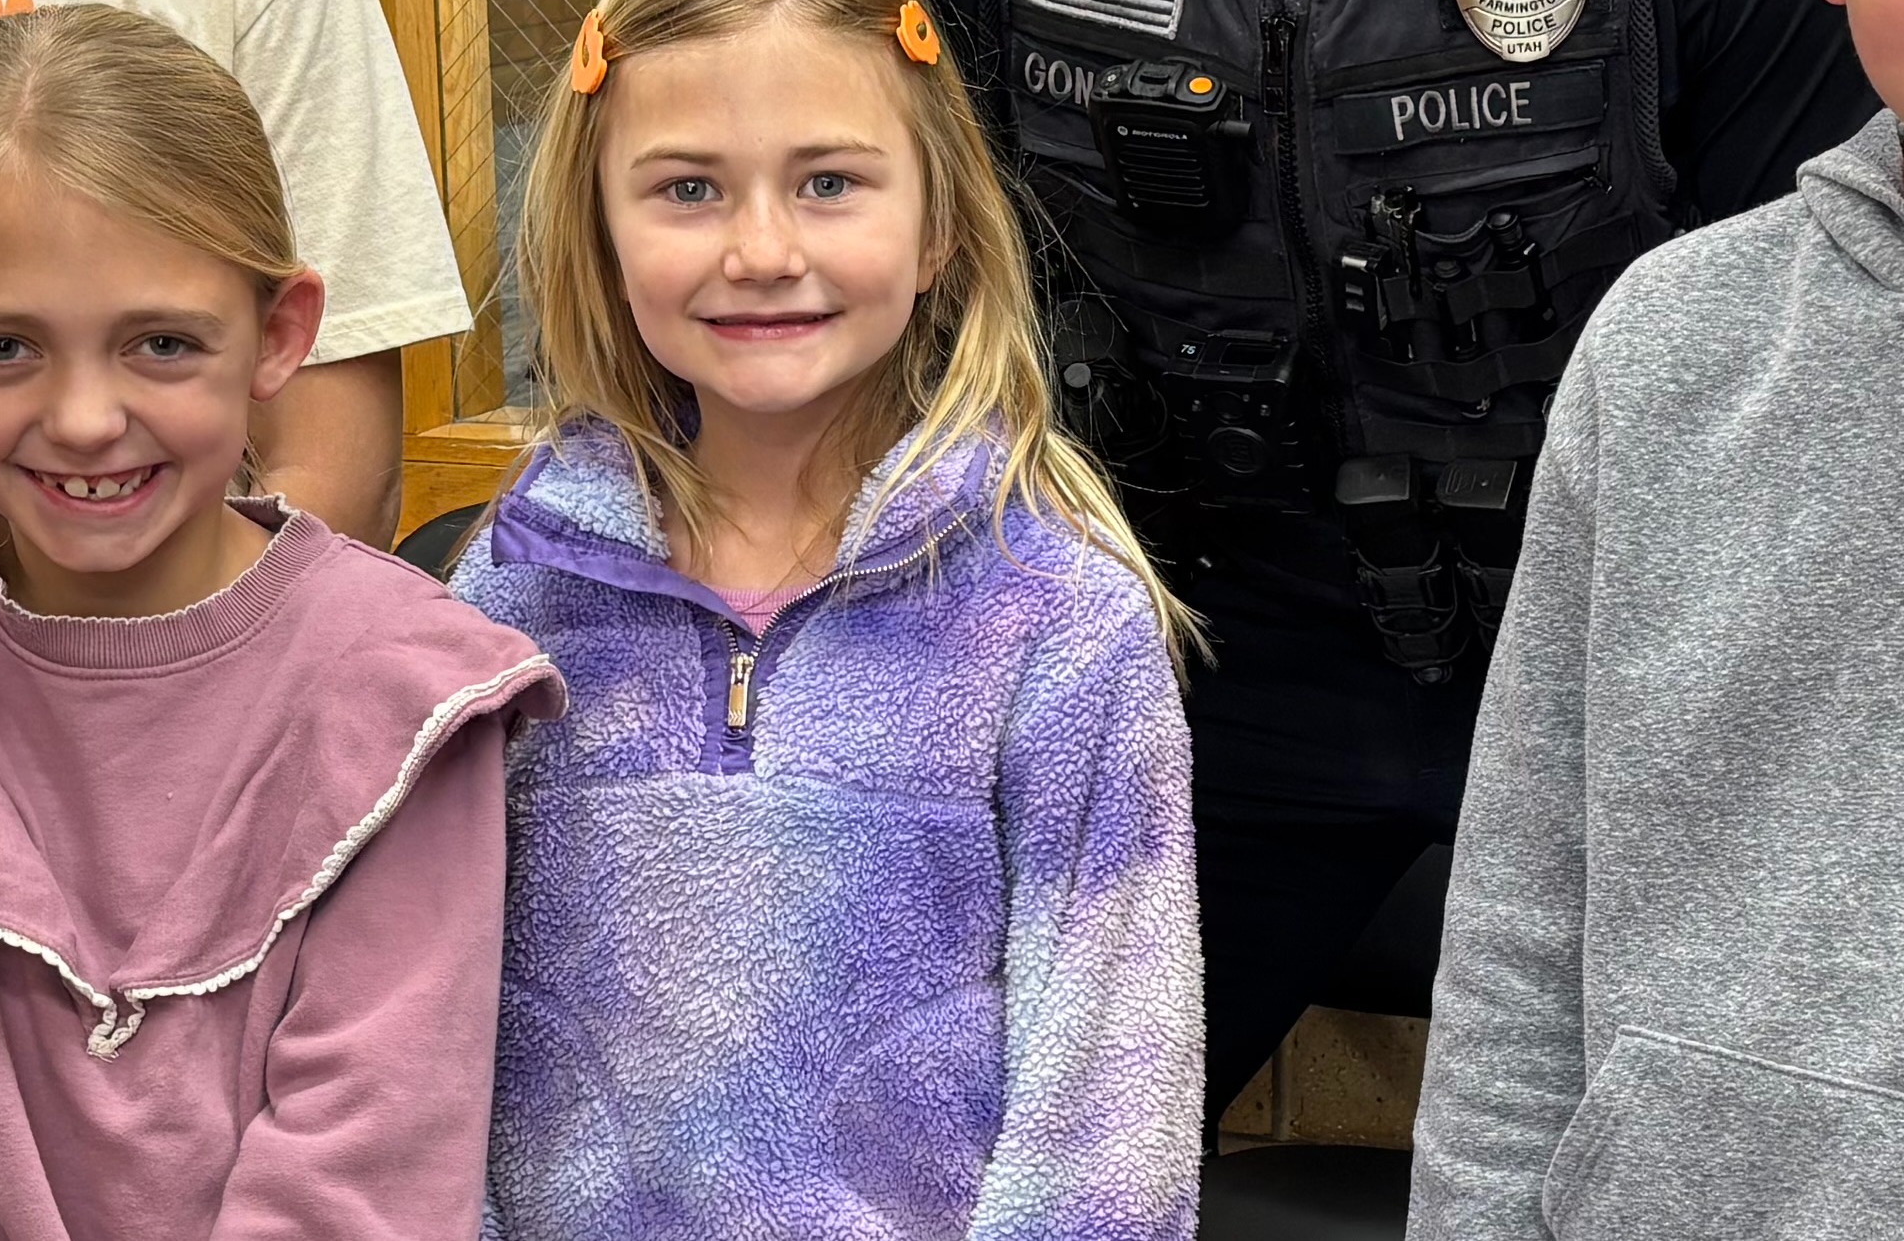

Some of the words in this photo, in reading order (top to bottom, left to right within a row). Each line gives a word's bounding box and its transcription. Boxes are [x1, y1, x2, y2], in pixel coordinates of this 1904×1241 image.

[1491, 14, 1556, 35] POLICE
[1507, 41, 1542, 54] UTAH
[1392, 80, 1532, 142] POLICE
[1132, 129, 1188, 139] MOTOROLA
[1181, 344, 1196, 355] 75
